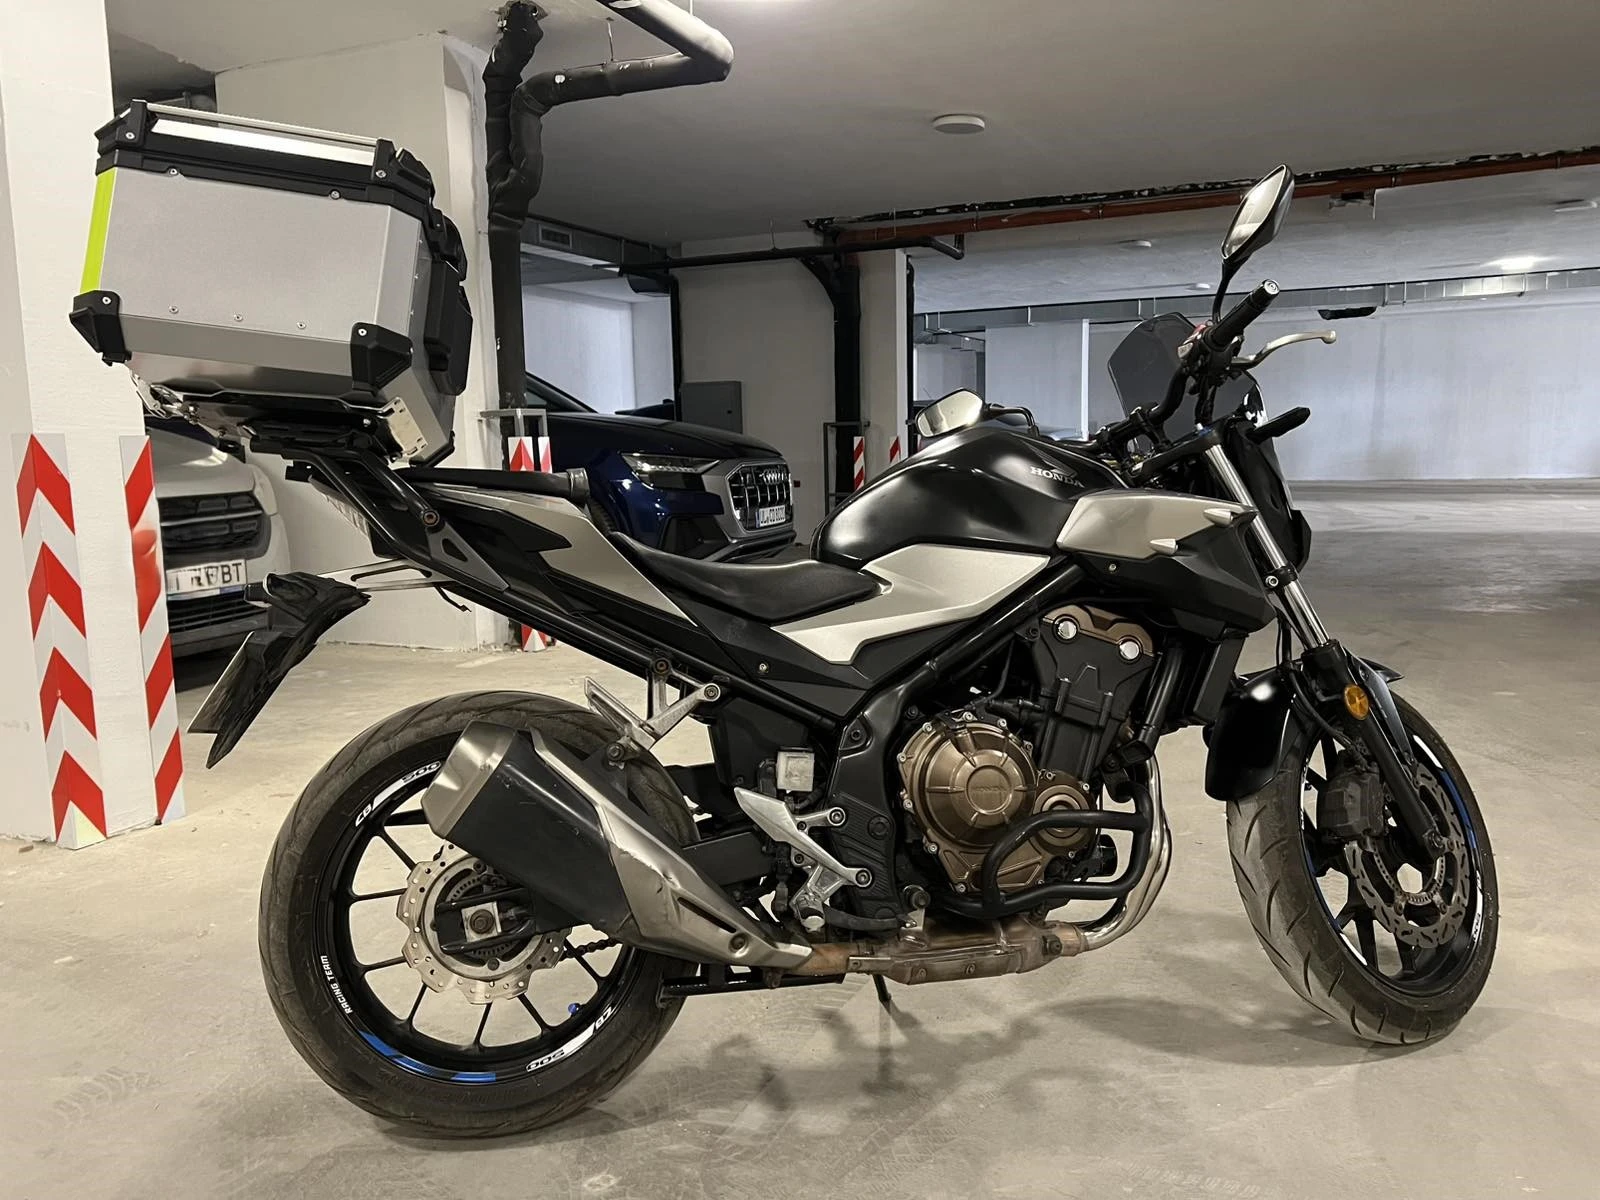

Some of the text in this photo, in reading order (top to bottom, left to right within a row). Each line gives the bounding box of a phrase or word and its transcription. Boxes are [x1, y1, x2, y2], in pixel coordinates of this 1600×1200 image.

[1030, 466, 1085, 488] HONDA
[355, 803, 372, 827] CB
[320, 955, 354, 1014] RACING TEAM
[526, 1006, 612, 1072] CB 500
